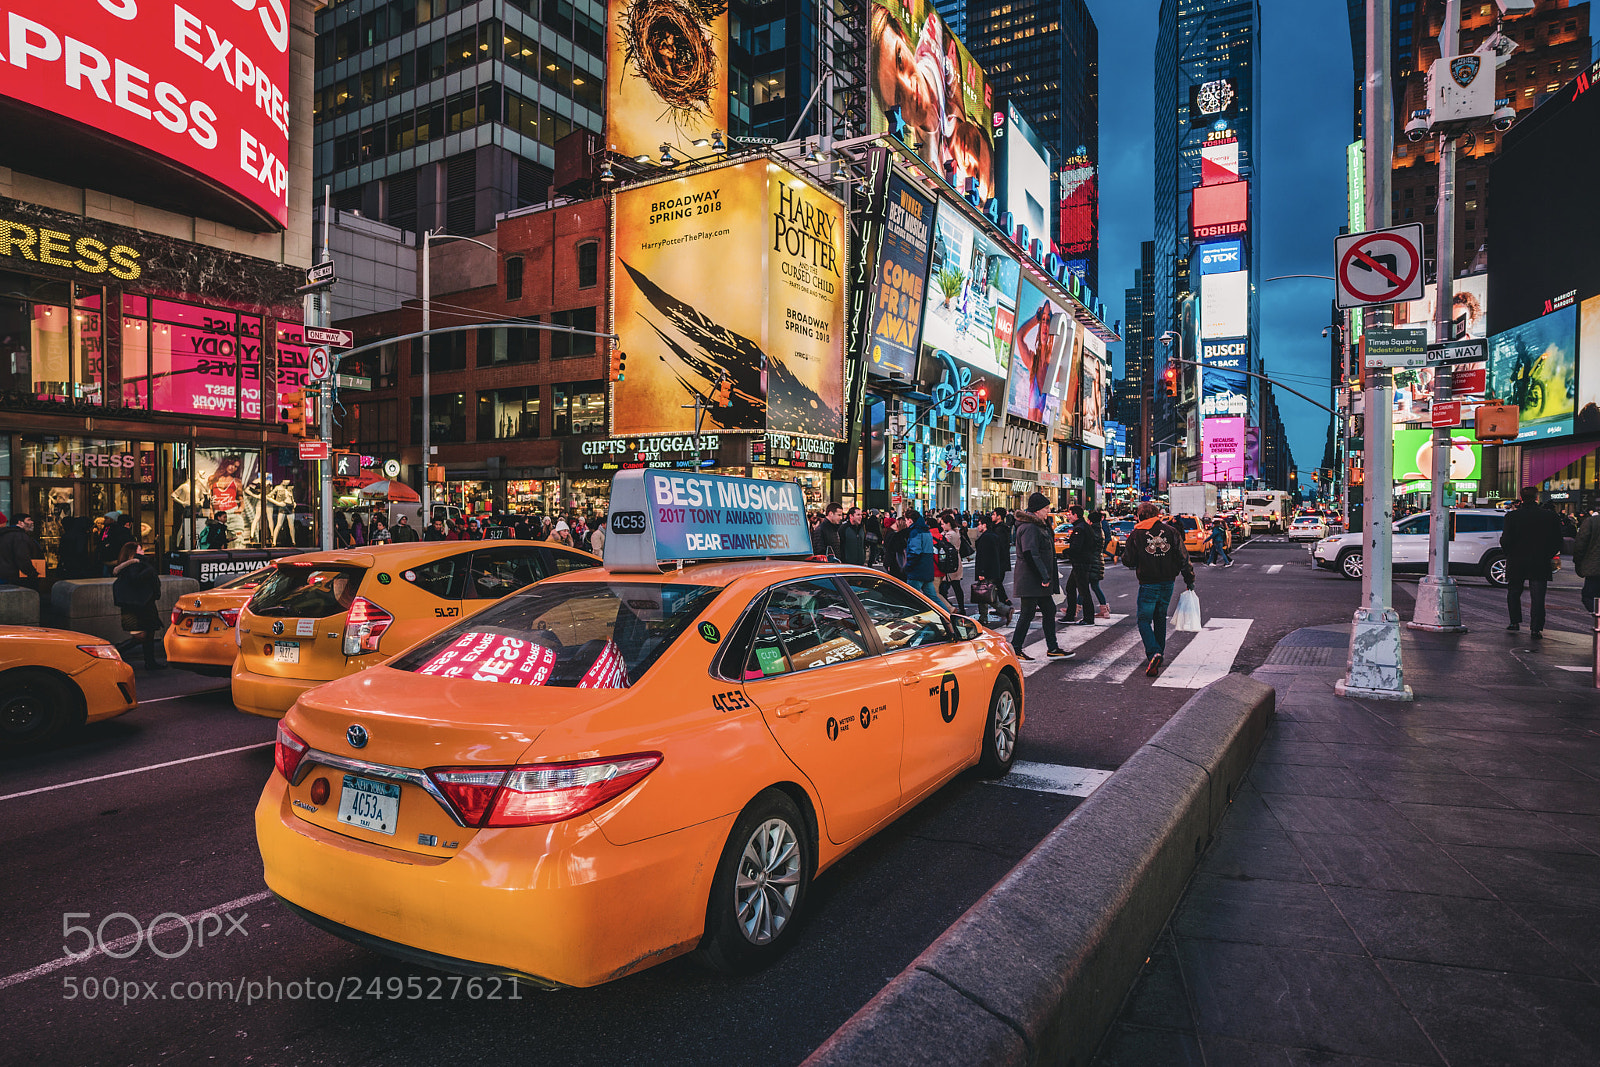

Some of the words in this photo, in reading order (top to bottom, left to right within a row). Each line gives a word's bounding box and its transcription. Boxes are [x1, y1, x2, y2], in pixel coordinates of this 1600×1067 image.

[0, 11, 218, 150] PRESS
[1202, 136, 1238, 148] TOSHIBA
[1207, 128, 1232, 141] 2018
[241, 128, 289, 207] EXP
[651, 188, 721, 213] BROADWAY
[649, 207, 692, 225] SPRING
[697, 201, 722, 216] 2018
[778, 180, 838, 246] HARRY
[889, 201, 905, 227] BEST
[641, 228, 730, 250] HarryPotterThePlay.com
[1193, 222, 1247, 238] TOSHIBA
[774, 212, 841, 279] POTTER
[314, 267, 323, 277] ONE
[323, 265, 332, 274] WAY
[781, 262, 811, 285] CURSED
[812, 275, 834, 295] CHILD
[883, 259, 923, 301] COME
[786, 308, 829, 331] BROADWAY
[310, 332, 324, 340] ONE
[326, 333, 339, 341] WAY
[785, 320, 813, 338] SPRING
[815, 327, 831, 344] 2018
[875, 311, 918, 349] AWAY
[1203, 343, 1246, 358] BUSCH
[1391, 339, 1417, 347] Square
[1427, 349, 1450, 361] ONE
[1455, 346, 1478, 357] WAY
[349, 377, 353, 386] 7
[582, 440, 626, 455] GIFTS
[638, 435, 719, 452] LUGGAGE
[796, 436, 835, 455] LUGGAGE
[41, 451, 135, 469] EXPRESS
[634, 453, 639, 461] I
[645, 452, 660, 461] NY
[653, 475, 714, 507] BEST
[716, 481, 799, 512] MUSICAL
[1486, 490, 1499, 498] 1515
[613, 515, 646, 529] 4C53
[659, 508, 687, 523] 2017
[689, 509, 721, 524] TONY
[726, 510, 763, 525] AWARD
[764, 512, 801, 526] WINNER
[201, 561, 271, 573] BROADWAY
[929, 685, 939, 697] NYC
[712, 690, 751, 713] 4C53
[352, 791, 383, 822] 4C53A
[442, 841, 459, 849] LE
